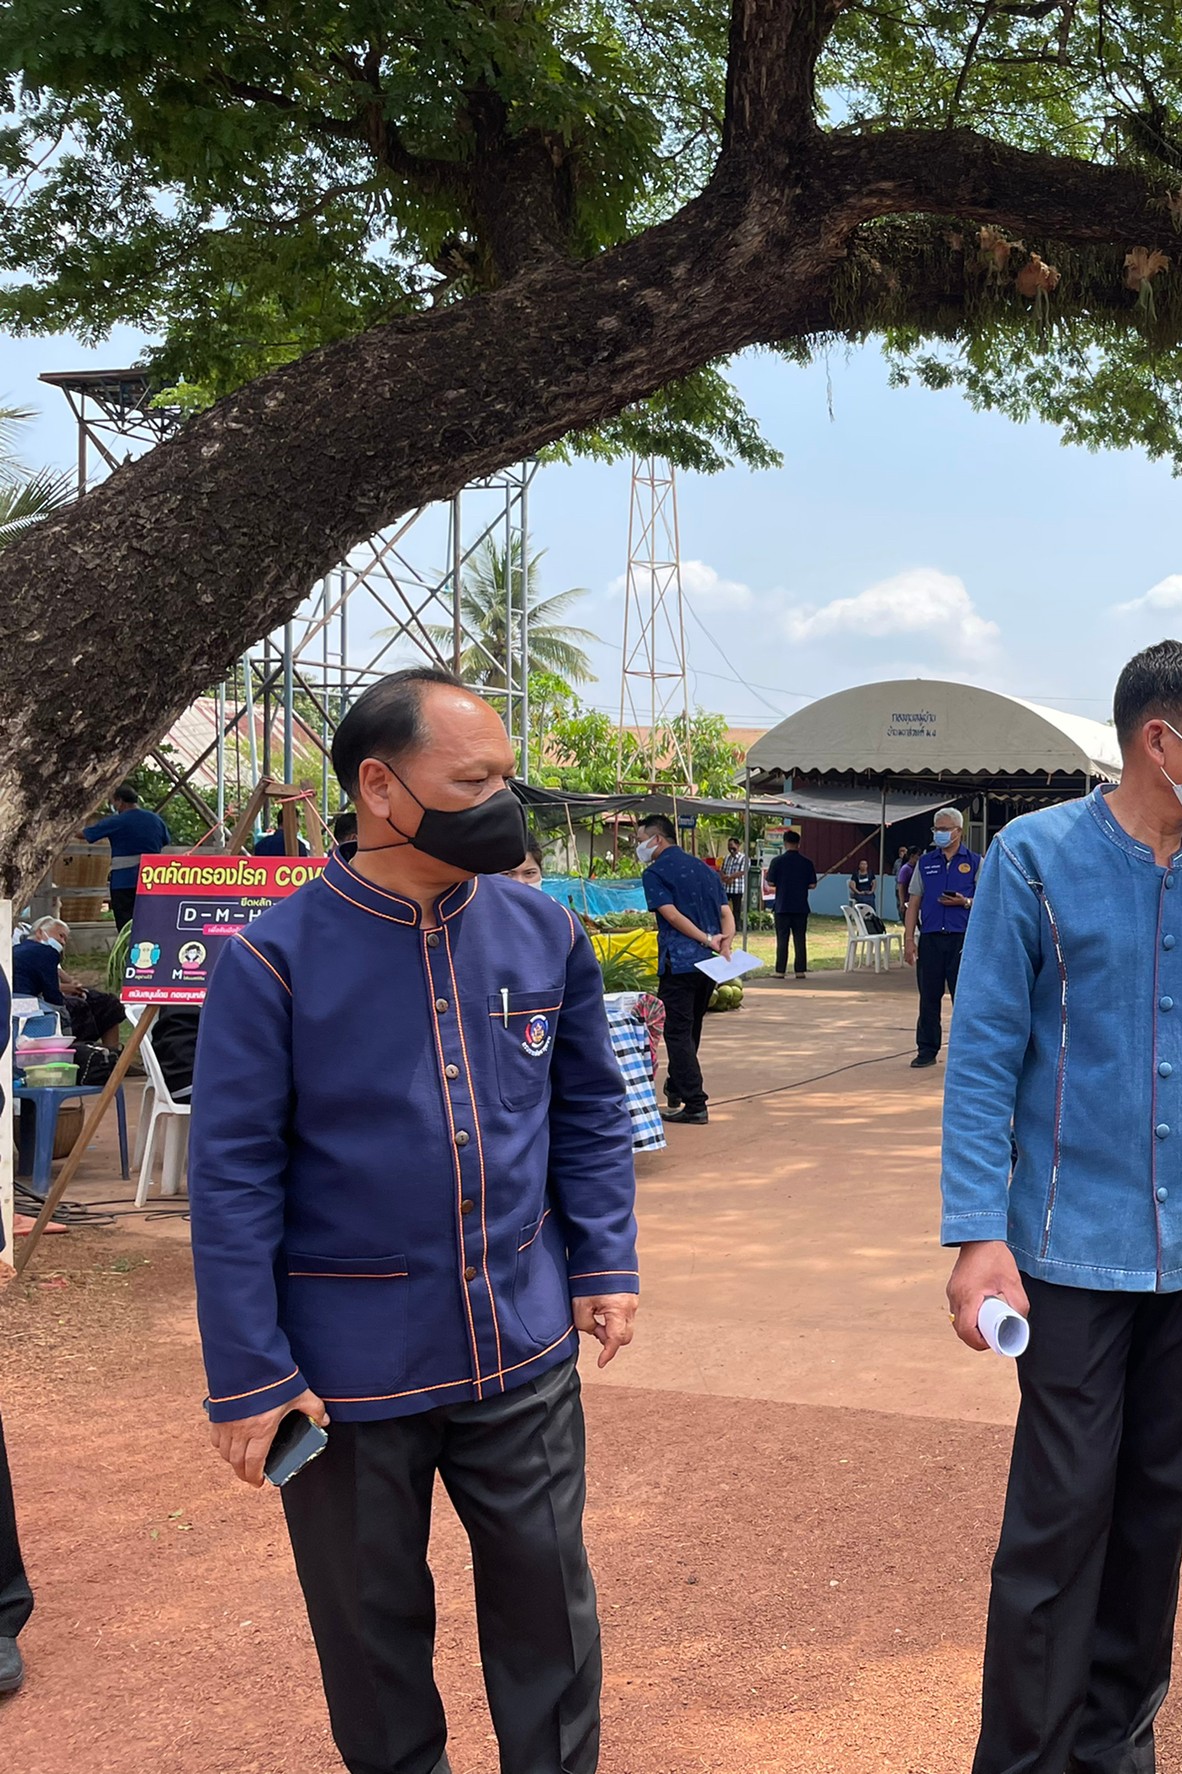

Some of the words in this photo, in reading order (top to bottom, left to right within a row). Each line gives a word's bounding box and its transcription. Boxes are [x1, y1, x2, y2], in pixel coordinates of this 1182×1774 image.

[141, 861, 267, 889] จุดคัดกรองโรค
[184, 908, 197, 921] D
[215, 909, 230, 922] M
[125, 967, 136, 979] D
[172, 969, 183, 980] M
